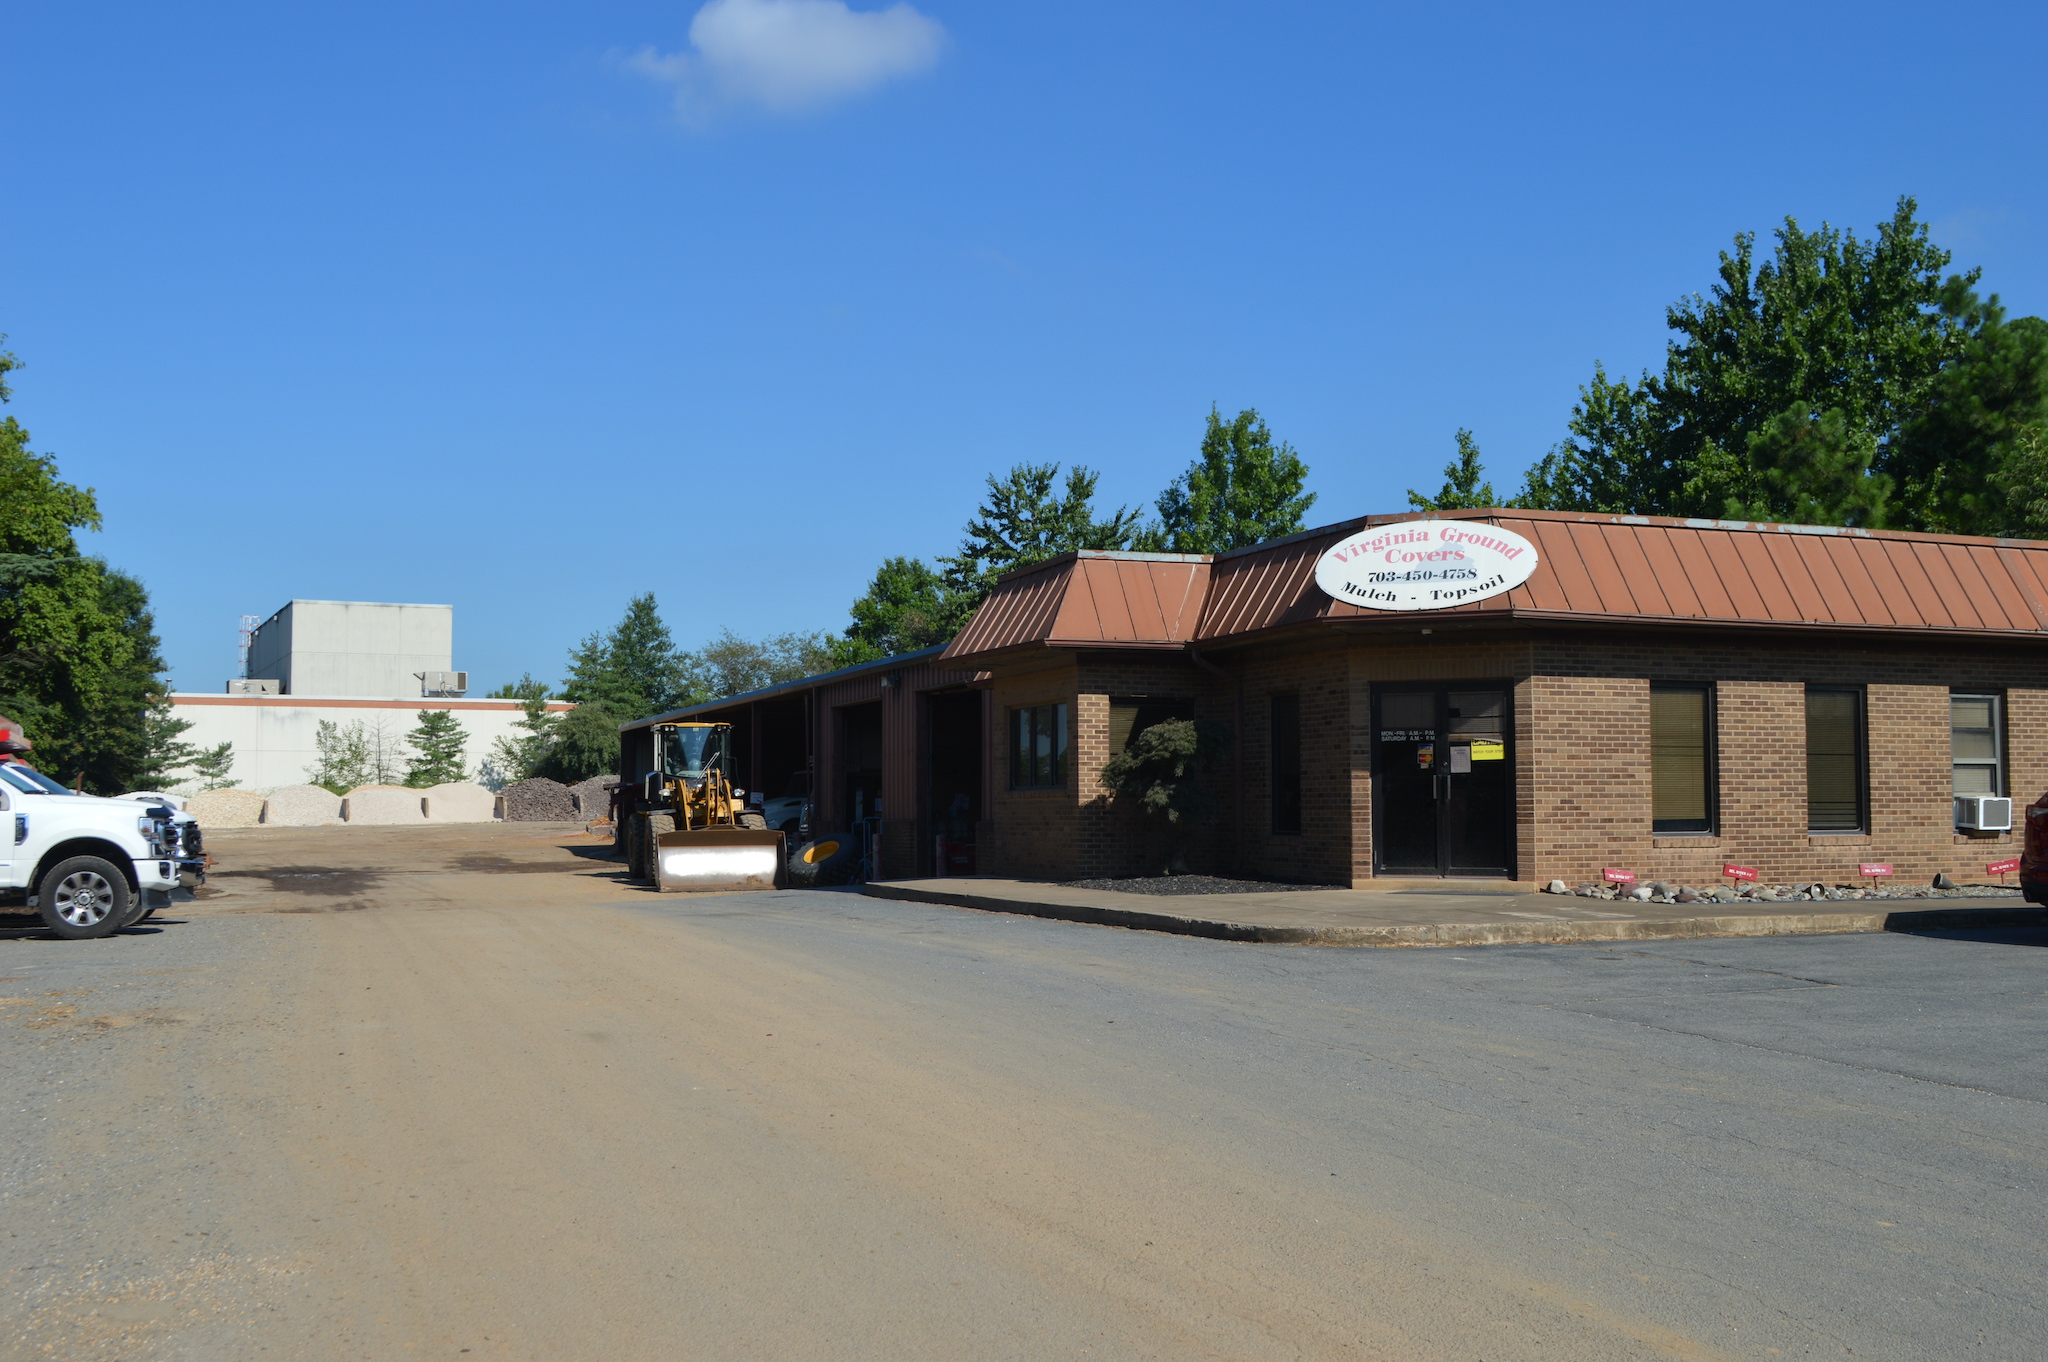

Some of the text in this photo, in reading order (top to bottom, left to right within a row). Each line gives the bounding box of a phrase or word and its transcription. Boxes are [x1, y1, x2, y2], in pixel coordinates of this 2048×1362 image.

[1332, 527, 1524, 564] Virginia Ground
[1384, 547, 1465, 564] Covers
[1367, 568, 1478, 583] 703-450-4758
[1341, 581, 1397, 602] Mulch
[1430, 574, 1506, 601] Topsoil
